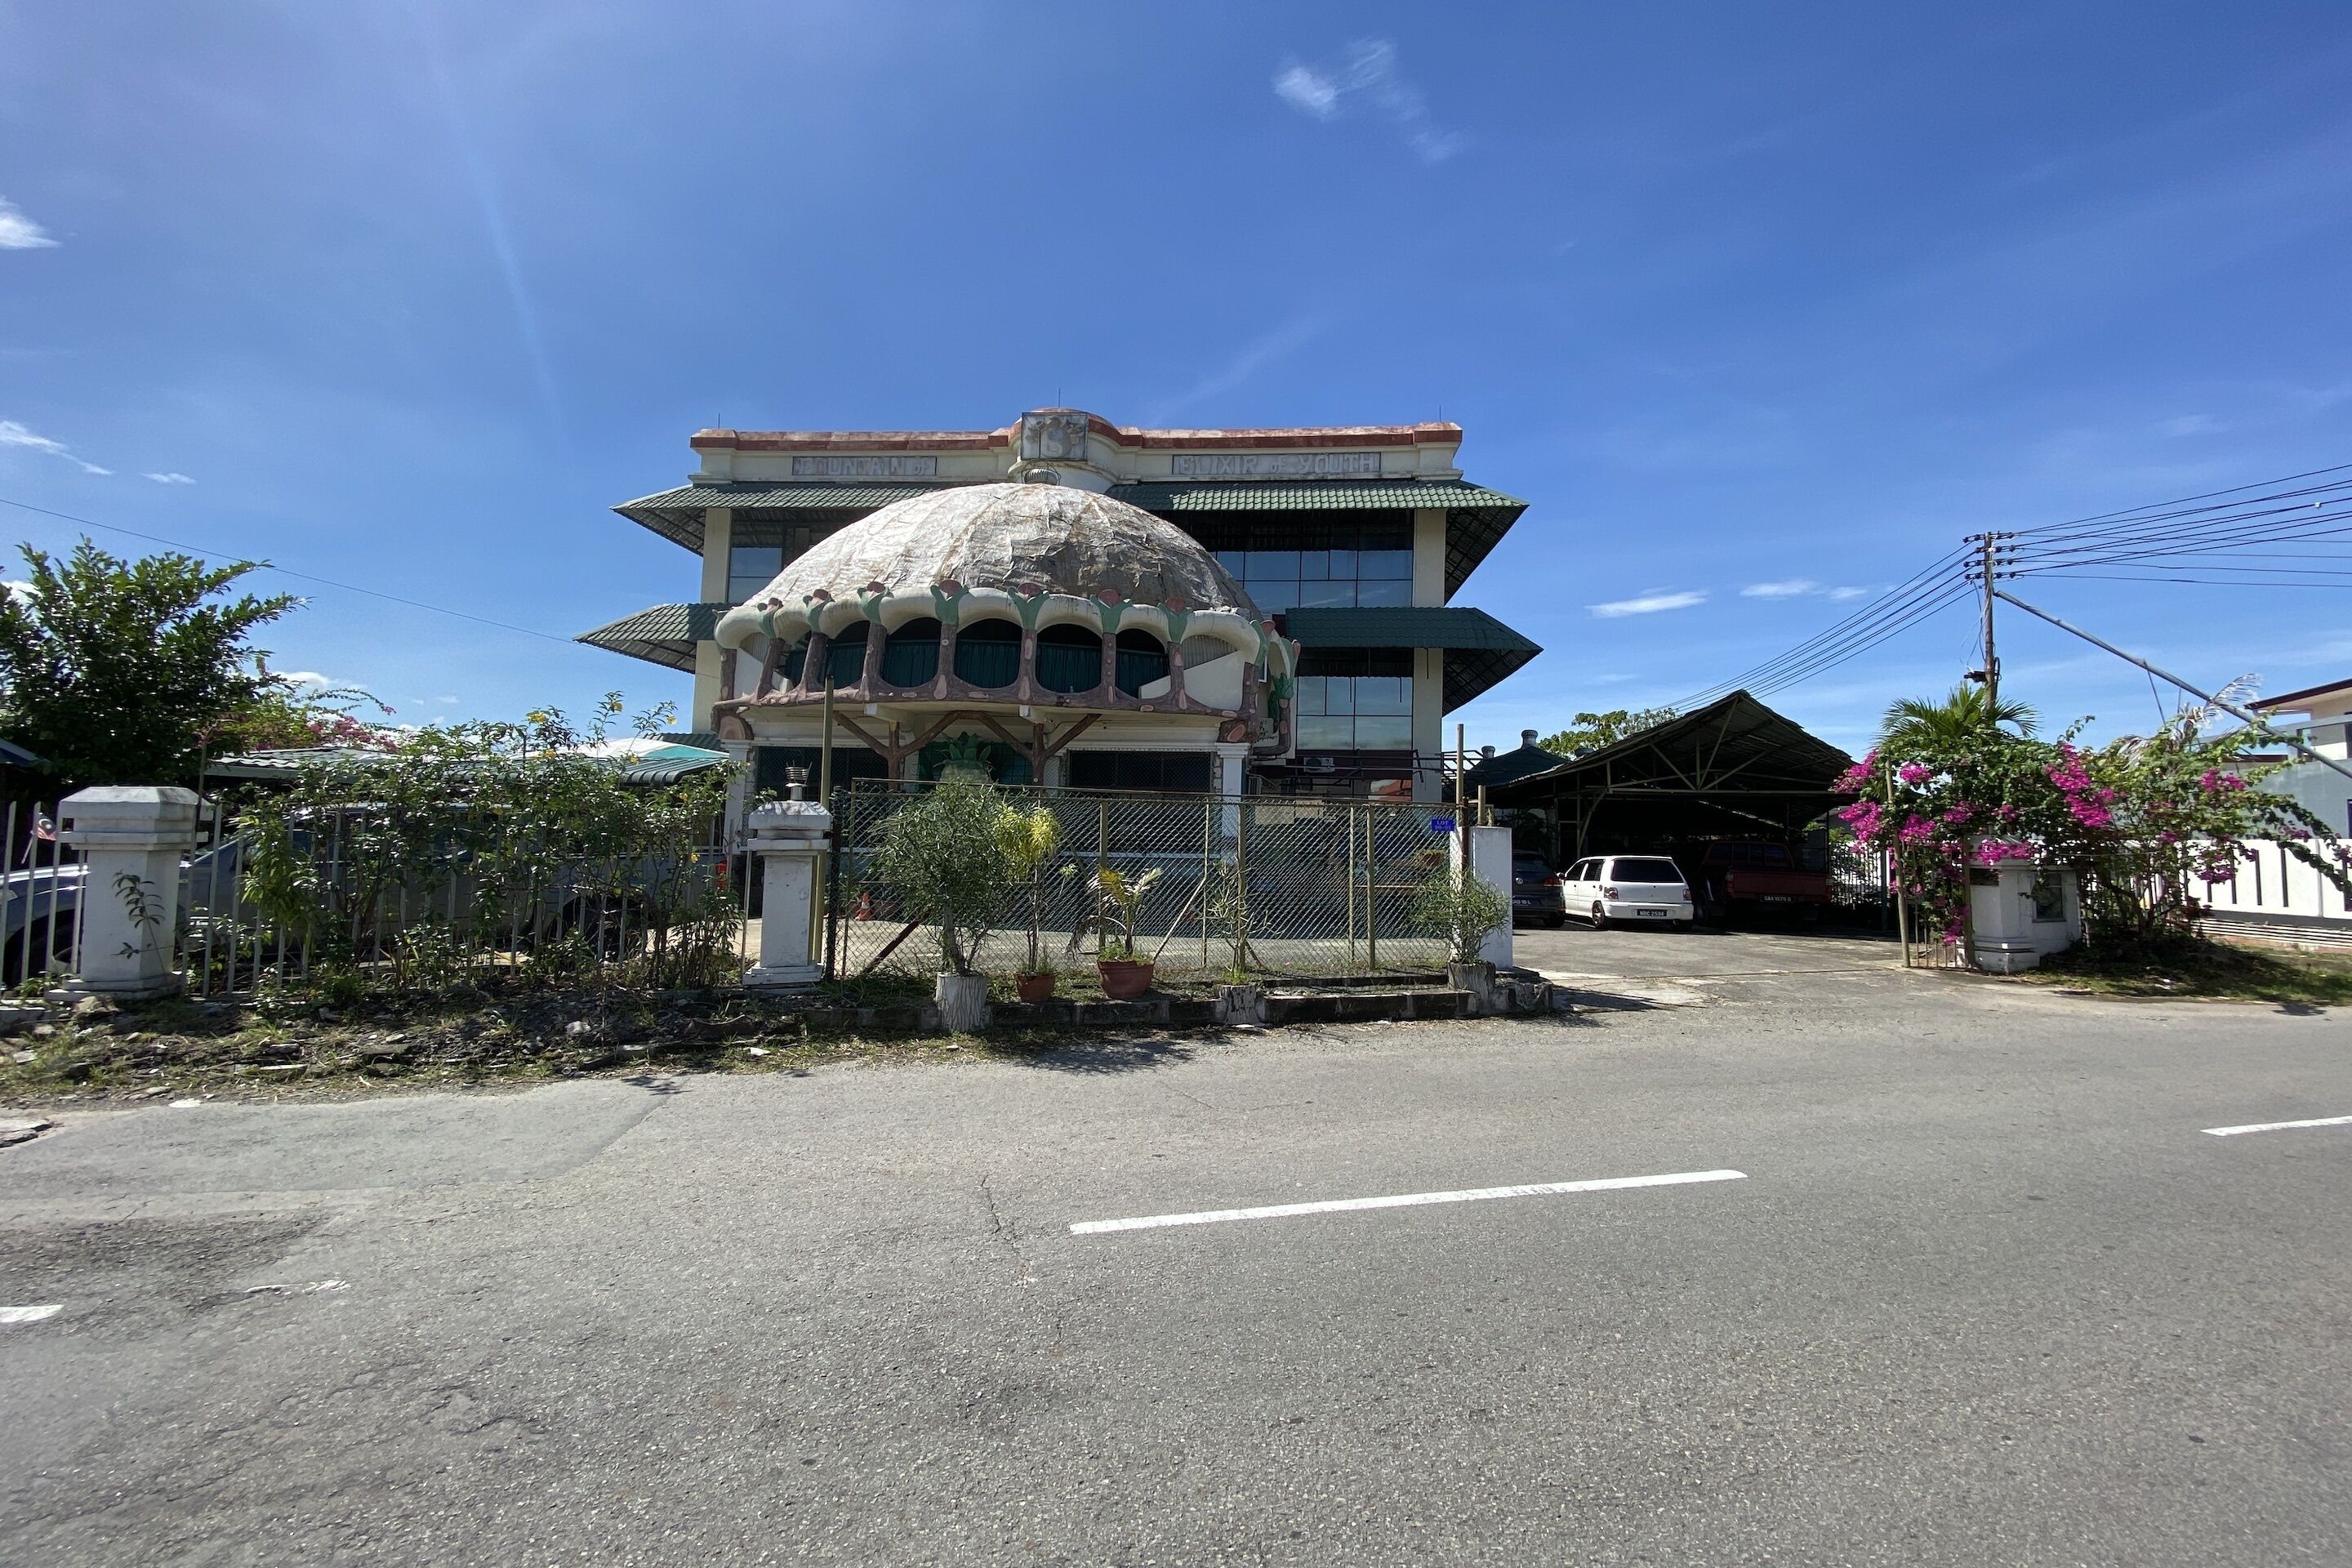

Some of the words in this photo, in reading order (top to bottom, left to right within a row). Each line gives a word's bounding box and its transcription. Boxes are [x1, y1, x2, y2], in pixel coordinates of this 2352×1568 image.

[799, 457, 905, 475] FOUNTAIN
[1178, 455, 1257, 474] ELIXIR
[1299, 453, 1375, 474] YOUTH
